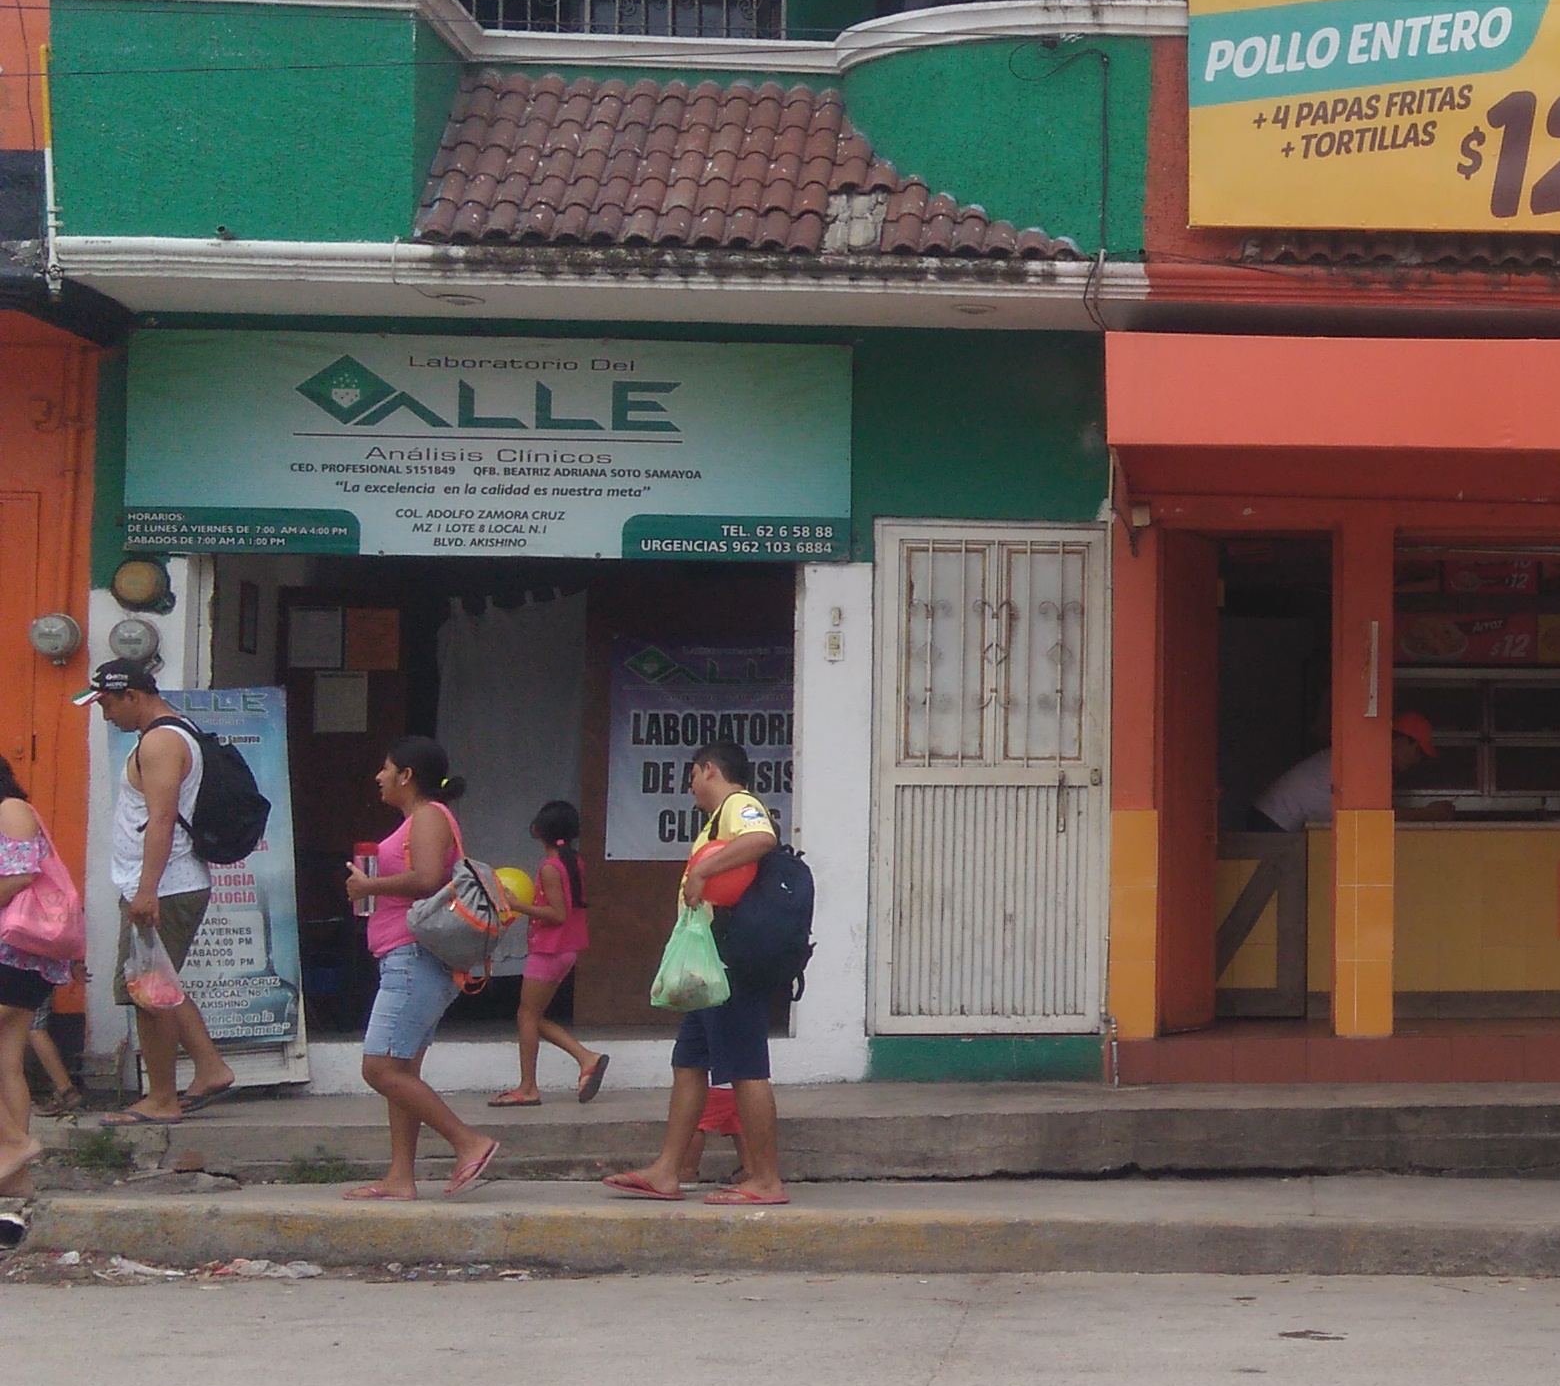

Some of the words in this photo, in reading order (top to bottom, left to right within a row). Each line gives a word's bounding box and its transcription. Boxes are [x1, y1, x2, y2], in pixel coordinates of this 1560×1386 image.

[1205, 27, 1340, 81] POLLO
[1347, 7, 1512, 64] ENTERO
[1295, 94, 1381, 127] PAPAS
[1385, 84, 1473, 117] FRITAS
[1301, 120, 1437, 159] TORTILLAS
[409, 355, 578, 371] Laboratorio
[591, 359, 635, 373] Del
[365, 447, 484, 462] Análisis
[497, 449, 612, 464] Clínicos
[290, 464, 317, 473] CED.
[321, 464, 402, 474] PROFESIONAL
[406, 466, 455, 475] 5151849
[503, 467, 551, 477] BEATRIZ
[553, 468, 607, 478] ADRIANA
[610, 469, 641, 479] SOTO
[644, 470, 702, 480] SAMAYOA
[364, 483, 435, 494] excelencia
[443, 486, 460, 495] en
[464, 483, 477, 495] la
[481, 484, 529, 496] calidad
[534, 487, 547, 496] es
[552, 485, 602, 497] nuestra
[426, 509, 474, 519] ADOLFO
[478, 510, 529, 520] ZAMORA
[532, 511, 565, 521] CRUZ
[127, 524, 142, 533] DE
[144, 525, 178, 533] LUNES
[190, 525, 234, 534] VIERNES
[236, 525, 250, 534] DE
[280, 526, 297, 535] AM
[332, 526, 348, 536] PM
[412, 523, 433, 533] MZ
[444, 524, 475, 533] LOTE
[478, 524, 485, 533] 8
[488, 524, 524, 534] LOCAL
[721, 525, 750, 537] TEL.
[756, 525, 774, 538] 62
[779, 525, 788, 538] 6
[792, 526, 810, 538] 58
[814, 526, 833, 538] 88
[128, 536, 177, 545] SABADOS
[180, 536, 193, 545] DE
[218, 536, 235, 545] AM
[270, 537, 286, 546] PM
[469, 538, 527, 548] AKISHINO
[640, 539, 728, 552] URGENCIAS
[732, 541, 759, 553] 962
[765, 541, 791, 553] 103
[796, 541, 833, 554] 6884
[632, 713, 793, 746] LABORATORI
[642, 761, 675, 794] DE
[209, 927, 252, 936] VIERNES
[238, 938, 253, 946] PM
[240, 958, 255, 966] PM
[206, 978, 249, 988] ZAMORA
[251, 977, 280, 987] CRUZ
[208, 990, 242, 999] LOCAL
[200, 1000, 249, 1009] AKISHINO
